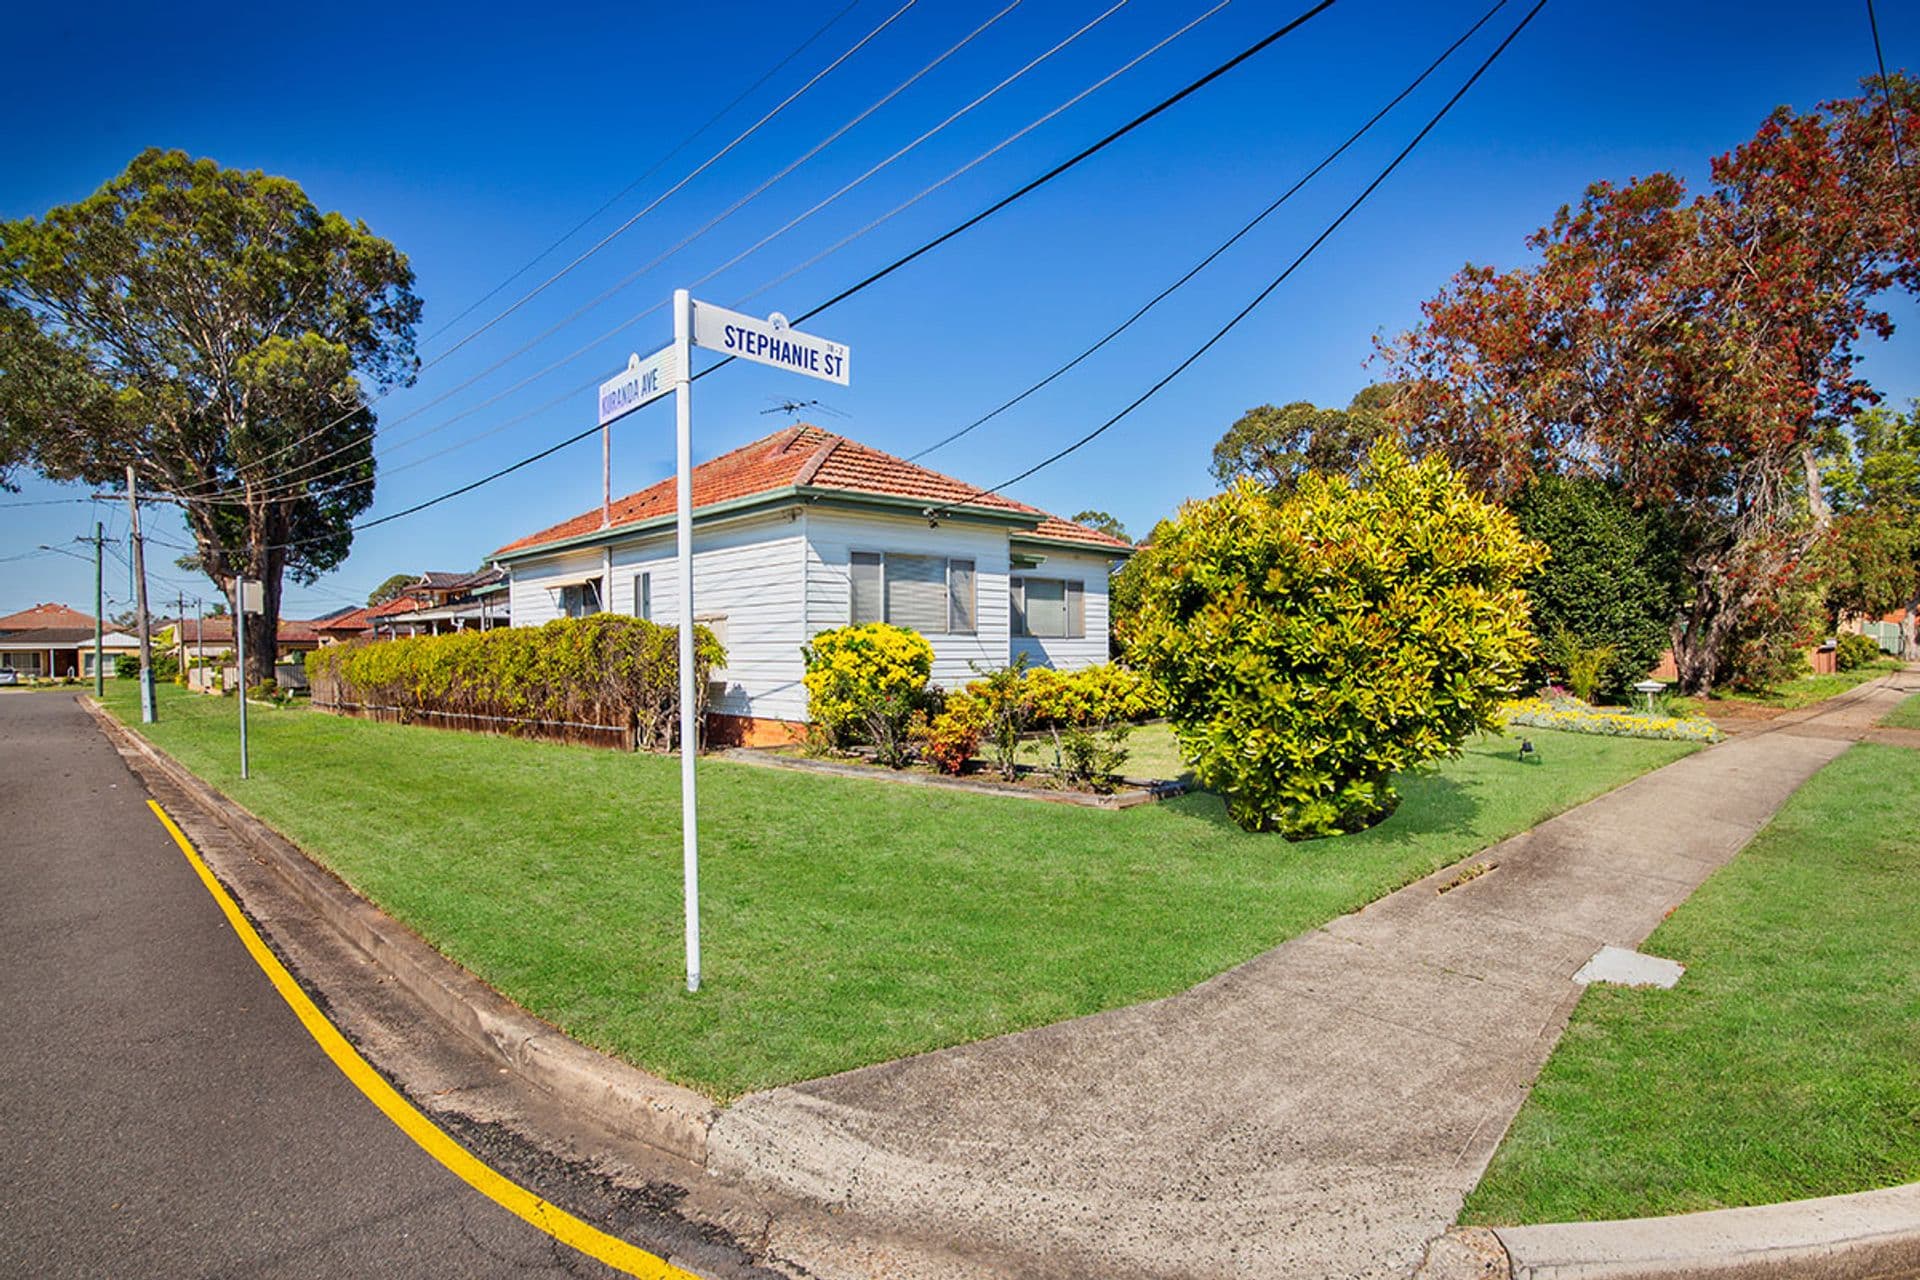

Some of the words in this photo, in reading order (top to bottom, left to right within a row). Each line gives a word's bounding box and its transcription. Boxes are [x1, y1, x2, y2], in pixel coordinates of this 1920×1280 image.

[725, 325, 819, 372] STEPHANIE
[824, 354, 843, 377] ST
[641, 368, 658, 397] AVE
